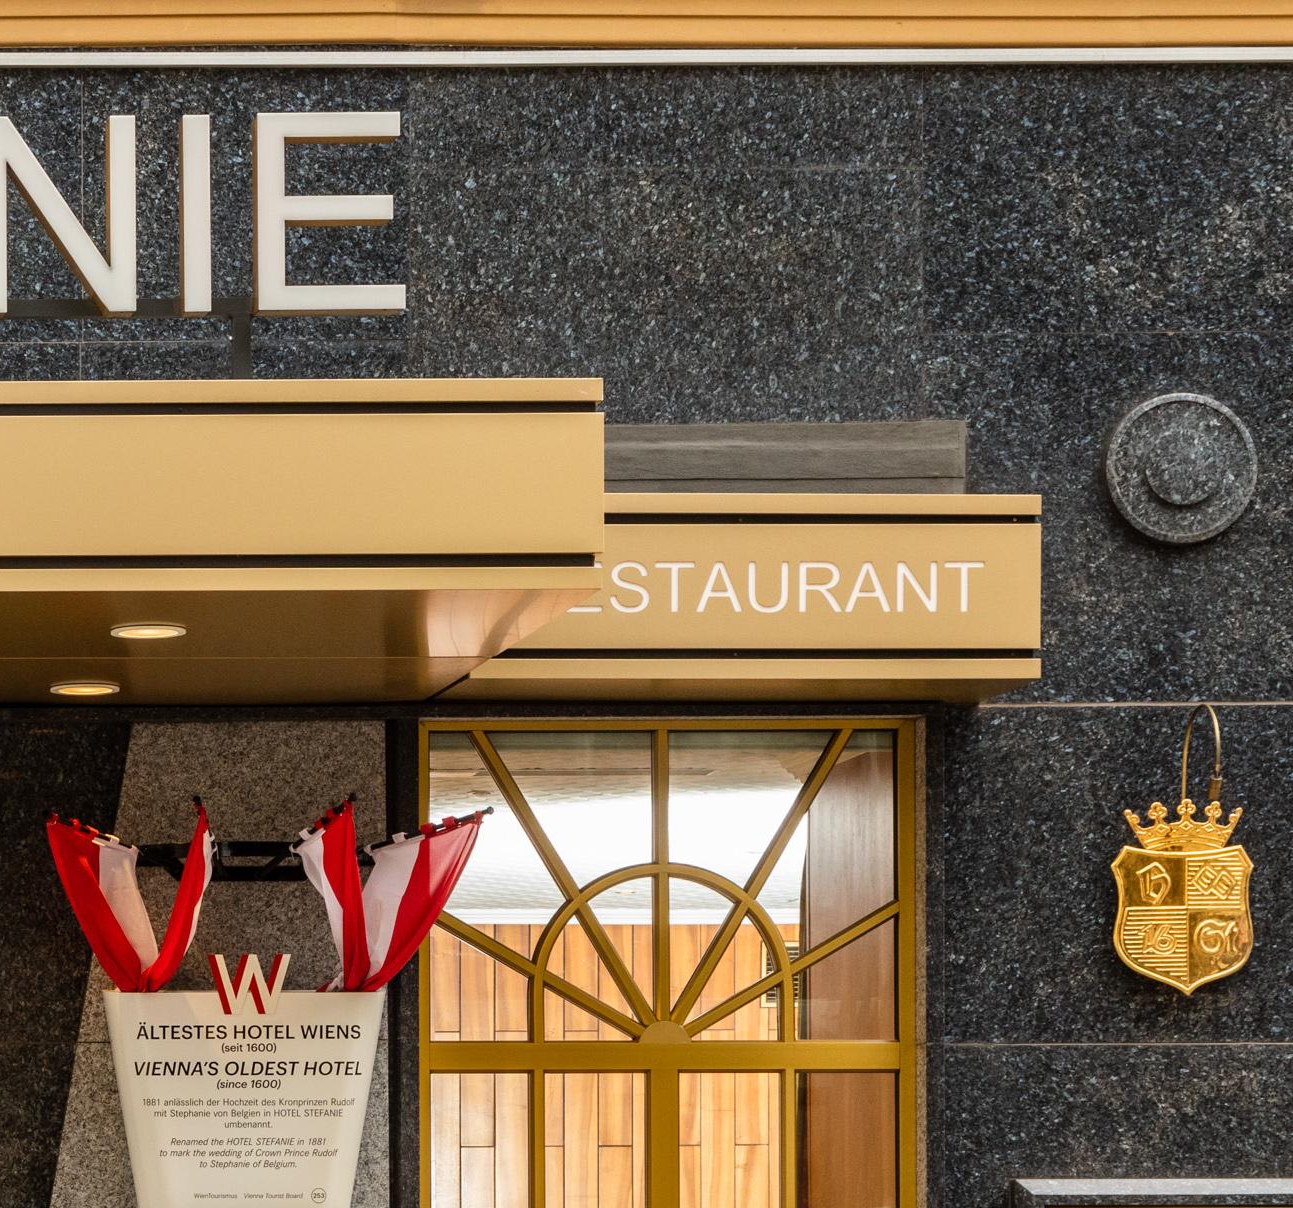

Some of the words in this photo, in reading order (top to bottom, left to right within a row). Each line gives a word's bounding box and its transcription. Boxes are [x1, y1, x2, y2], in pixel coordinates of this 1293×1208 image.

[207, 953, 291, 1015] W
[136, 1021, 228, 1040] ÄLTESTES
[233, 1025, 295, 1040] HOTEL
[300, 1025, 361, 1040] WIENS
[221, 1042, 243, 1053] (seit
[246, 1042, 277, 1053] 1600)
[225, 1061, 299, 1076] OLDEST
[303, 1061, 362, 1076] HOTEL
[216, 1078, 248, 1090] (since
[250, 1078, 281, 1090] 1600)
[142, 1098, 160, 1106] 1881
[163, 1097, 204, 1106] anlässlich
[206, 1097, 220, 1106] der
[223, 1098, 259, 1106] Hochzeit
[261, 1097, 276, 1106] des
[278, 1098, 328, 1108] Kronprinzen
[330, 1098, 355, 1106] Rudolf
[153, 1109, 167, 1117] mit
[170, 1109, 211, 1119] Stephanie
[231, 1109, 261, 1119] Belgien
[263, 1109, 271, 1117] in
[273, 1109, 301, 1117] HOTEL
[304, 1109, 343, 1117] STEFANIE
[224, 1120, 273, 1129] umbenannt.
[170, 1137, 209, 1146] Renamed
[211, 1137, 224, 1146] the
[226, 1137, 253, 1146] HOTEL
[255, 1137, 295, 1146] STEFANIE
[297, 1137, 305, 1146] in
[307, 1137, 327, 1146] 1881
[159, 1149, 168, 1157] to
[170, 1149, 191, 1157] mark
[193, 1149, 206, 1157] the
[208, 1149, 242, 1158] wedding
[244, 1149, 254, 1157] of
[255, 1149, 282, 1157] Crown
[284, 1149, 310, 1157] Prince
[312, 1149, 338, 1157] Rudolf
[199, 1160, 208, 1168] to
[210, 1160, 250, 1170] Stephanie
[252, 1160, 262, 1168] of
[263, 1160, 298, 1170] Belgium.
